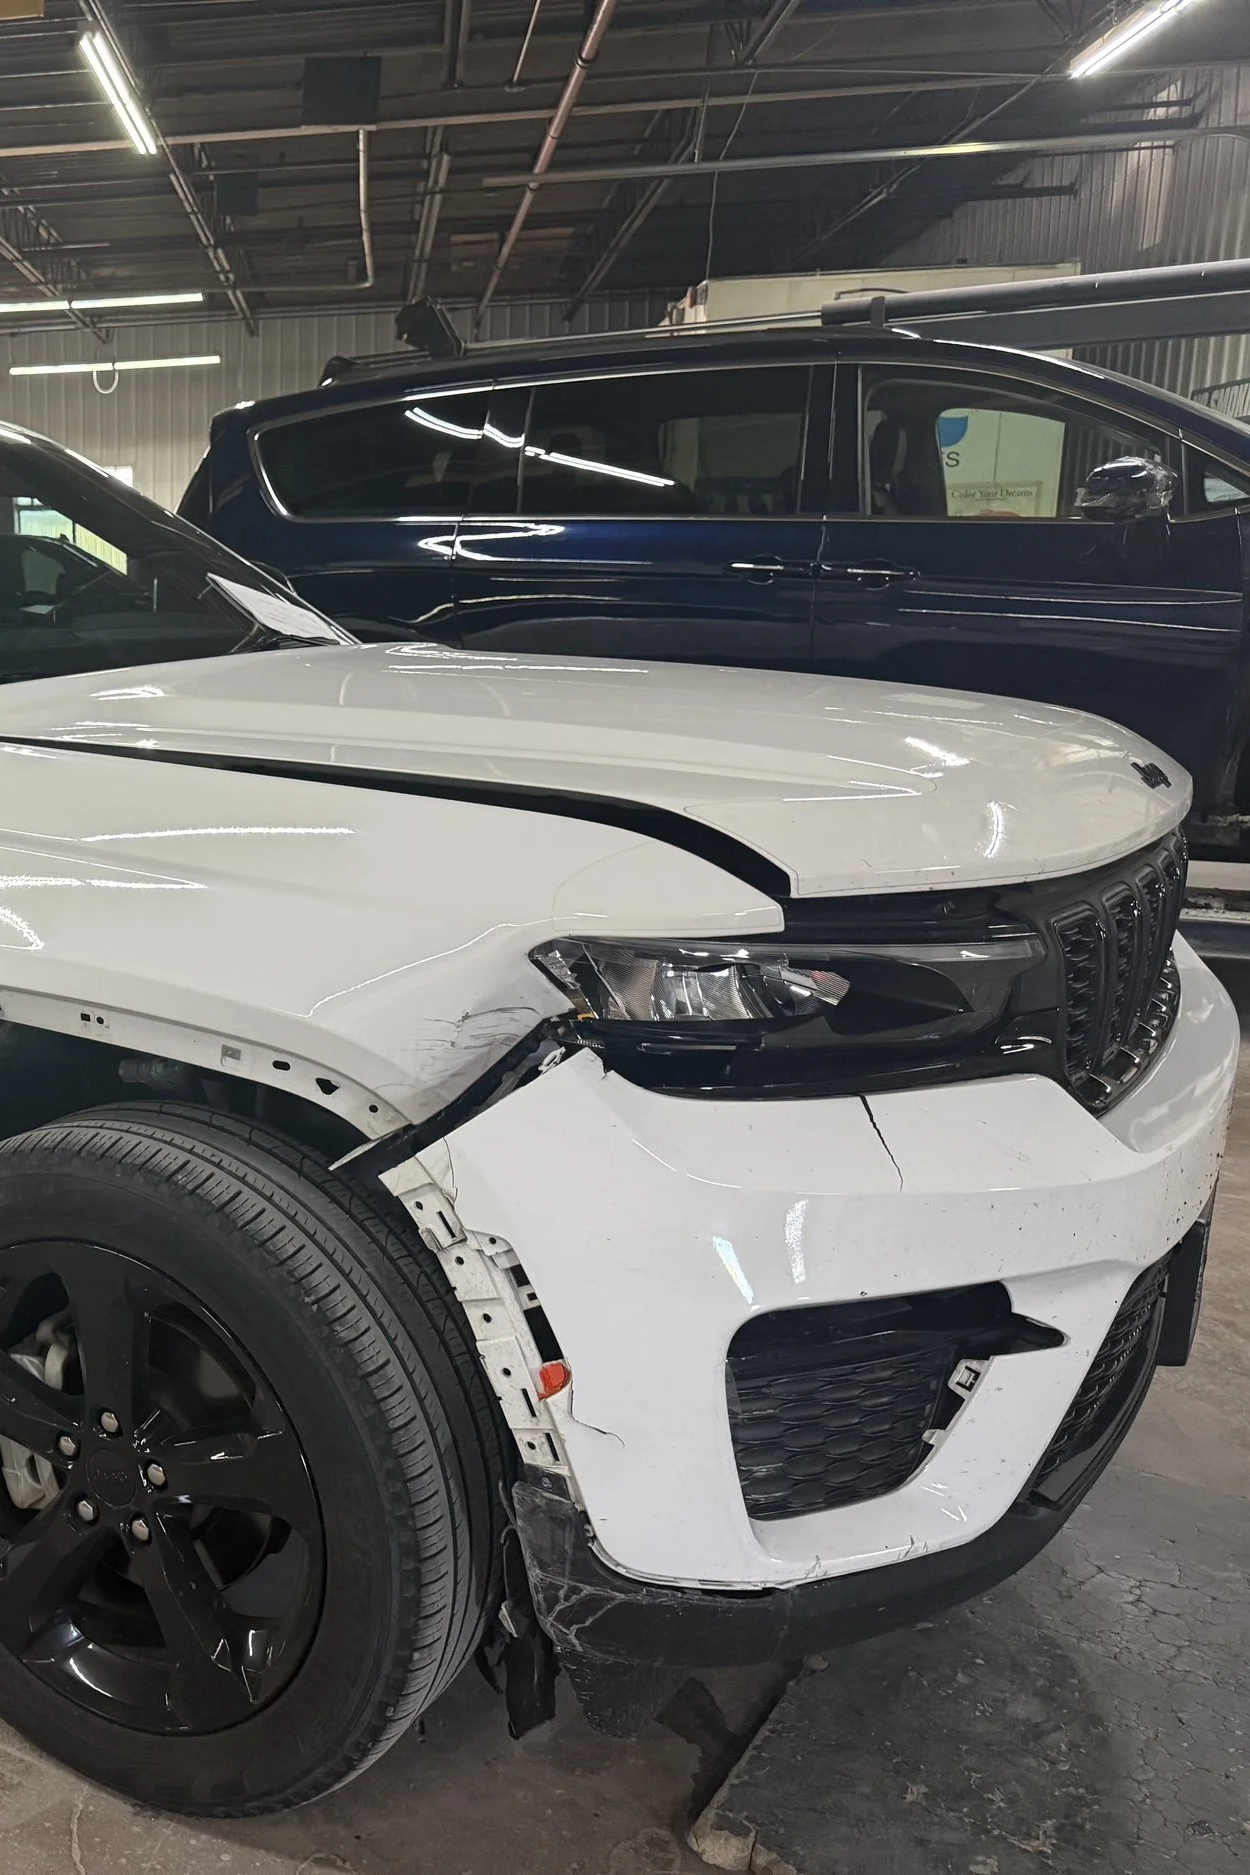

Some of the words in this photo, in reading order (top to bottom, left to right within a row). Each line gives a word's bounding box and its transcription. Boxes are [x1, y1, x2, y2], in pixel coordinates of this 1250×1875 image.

[941, 451, 960, 468] S
[951, 488, 975, 498] Color
[977, 488, 999, 498] Your
[1000, 488, 1033, 498] Dreams
